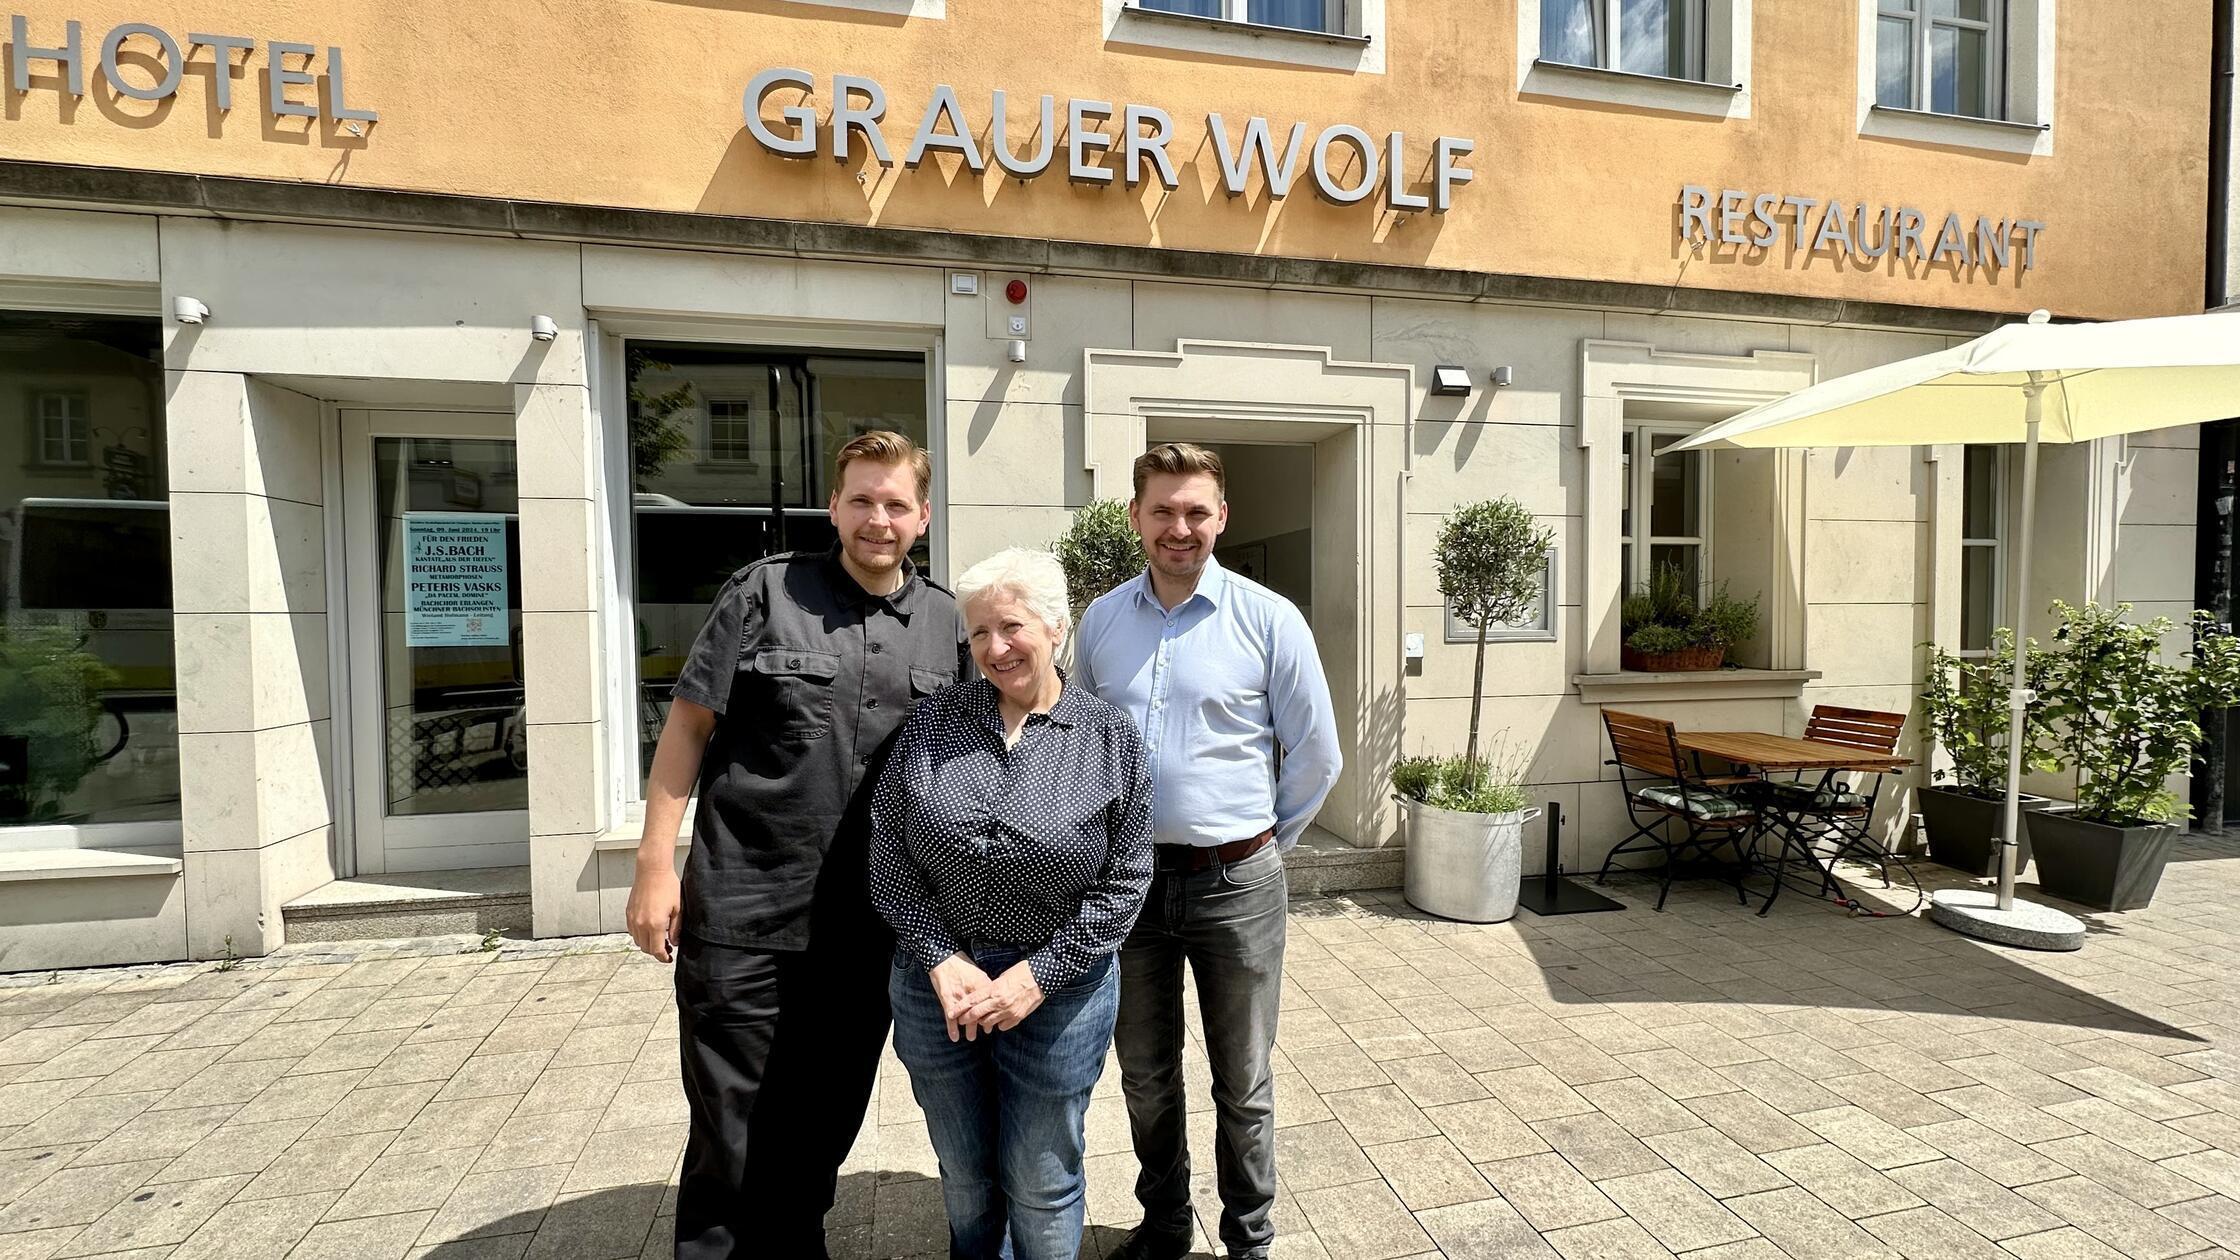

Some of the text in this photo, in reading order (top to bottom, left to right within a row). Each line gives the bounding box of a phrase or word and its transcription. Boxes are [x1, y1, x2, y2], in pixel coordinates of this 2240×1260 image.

[11, 14, 378, 123] HOTEL
[742, 67, 1475, 215] GRAUER WOLF
[1681, 184, 2046, 270] RESTAURANT
[411, 564, 503, 573] RICHARD STRAUSS
[425, 545, 485, 556] J.S.BACH
[411, 582, 502, 592] PETERIS VASKS
